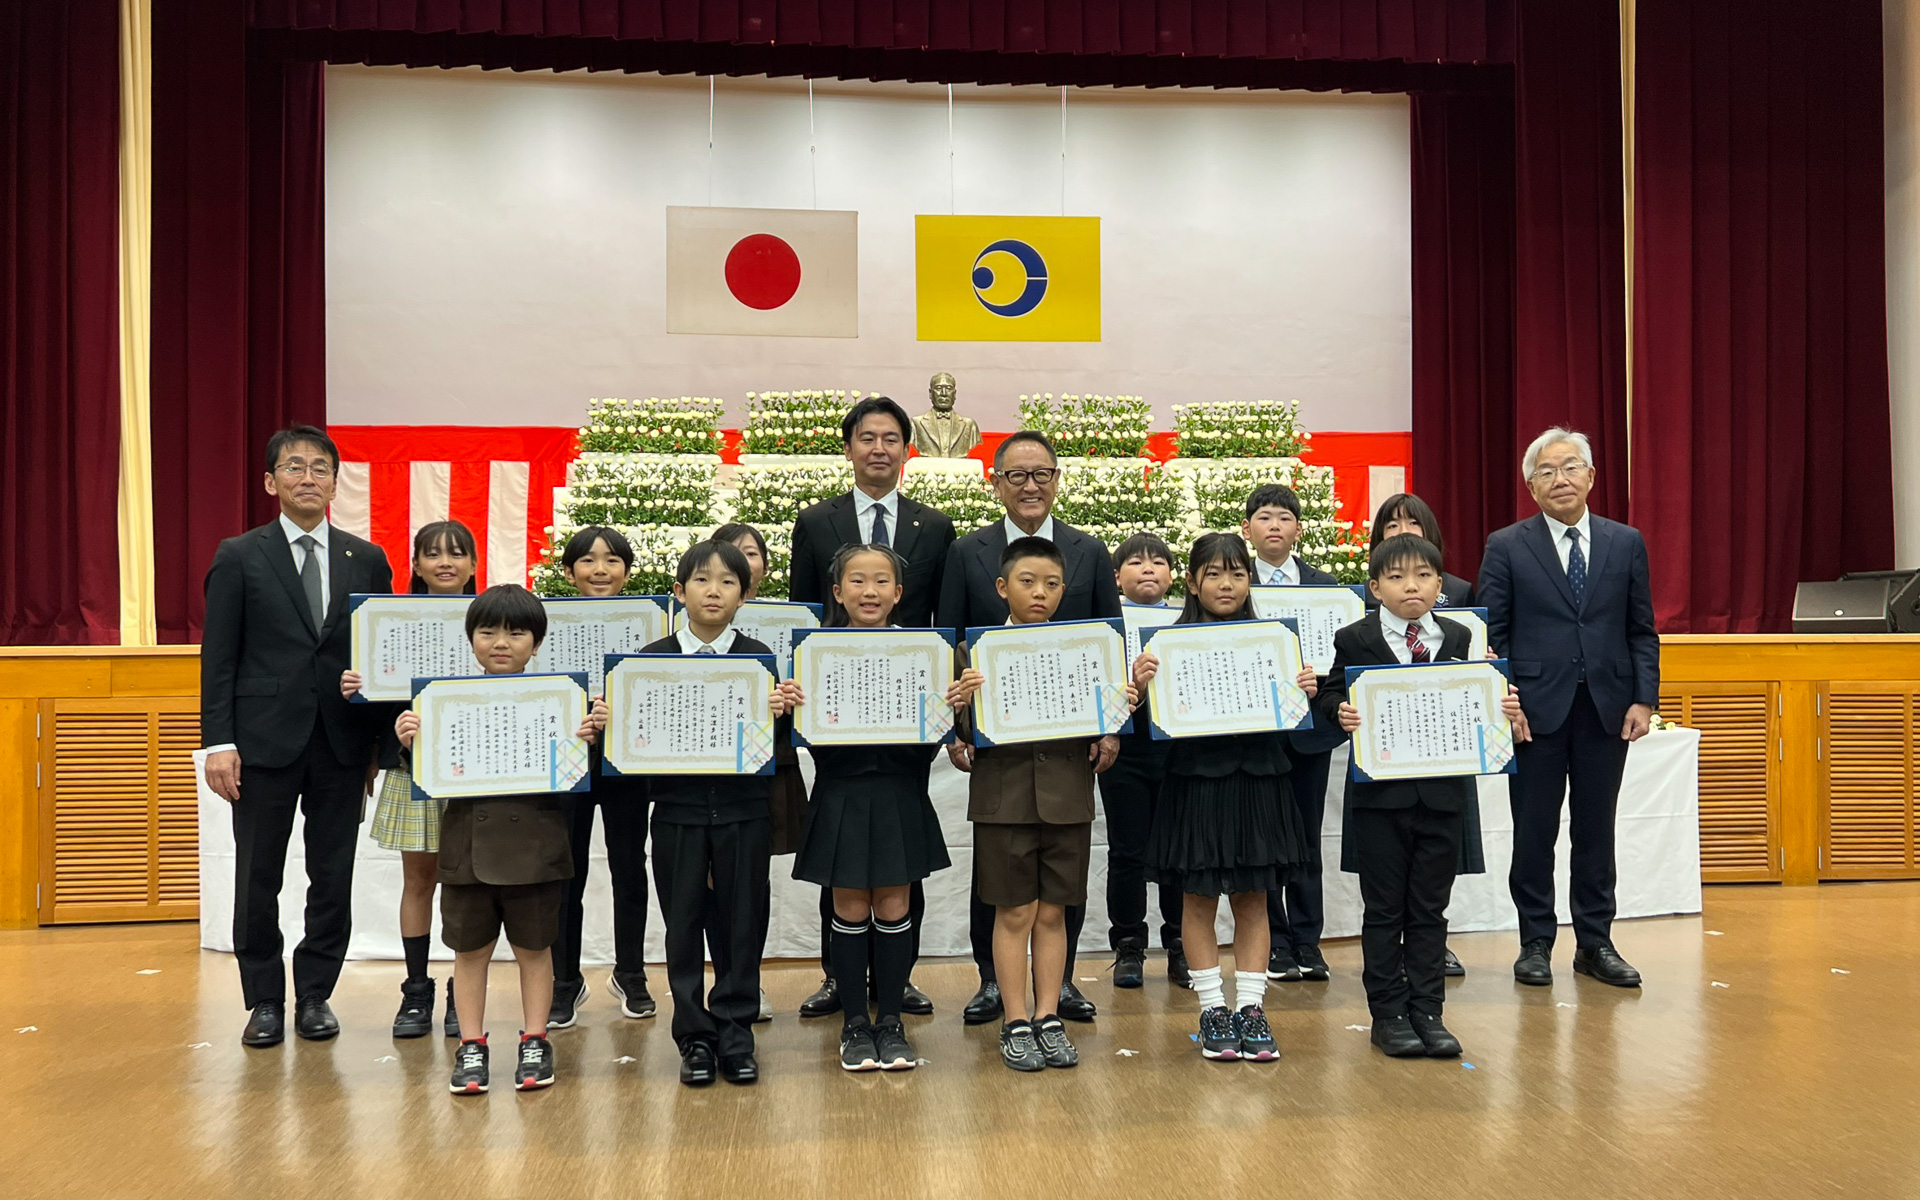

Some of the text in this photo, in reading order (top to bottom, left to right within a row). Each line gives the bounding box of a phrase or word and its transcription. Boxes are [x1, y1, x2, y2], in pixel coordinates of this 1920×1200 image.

[918, 669, 926, 691] 賞状
[1091, 660, 1100, 683] 賞状
[1266, 659, 1276, 680] 賞状
[736, 696, 745, 720] 賞状
[1472, 701, 1482, 723] 賞状
[549, 715, 558, 738] 賞状
